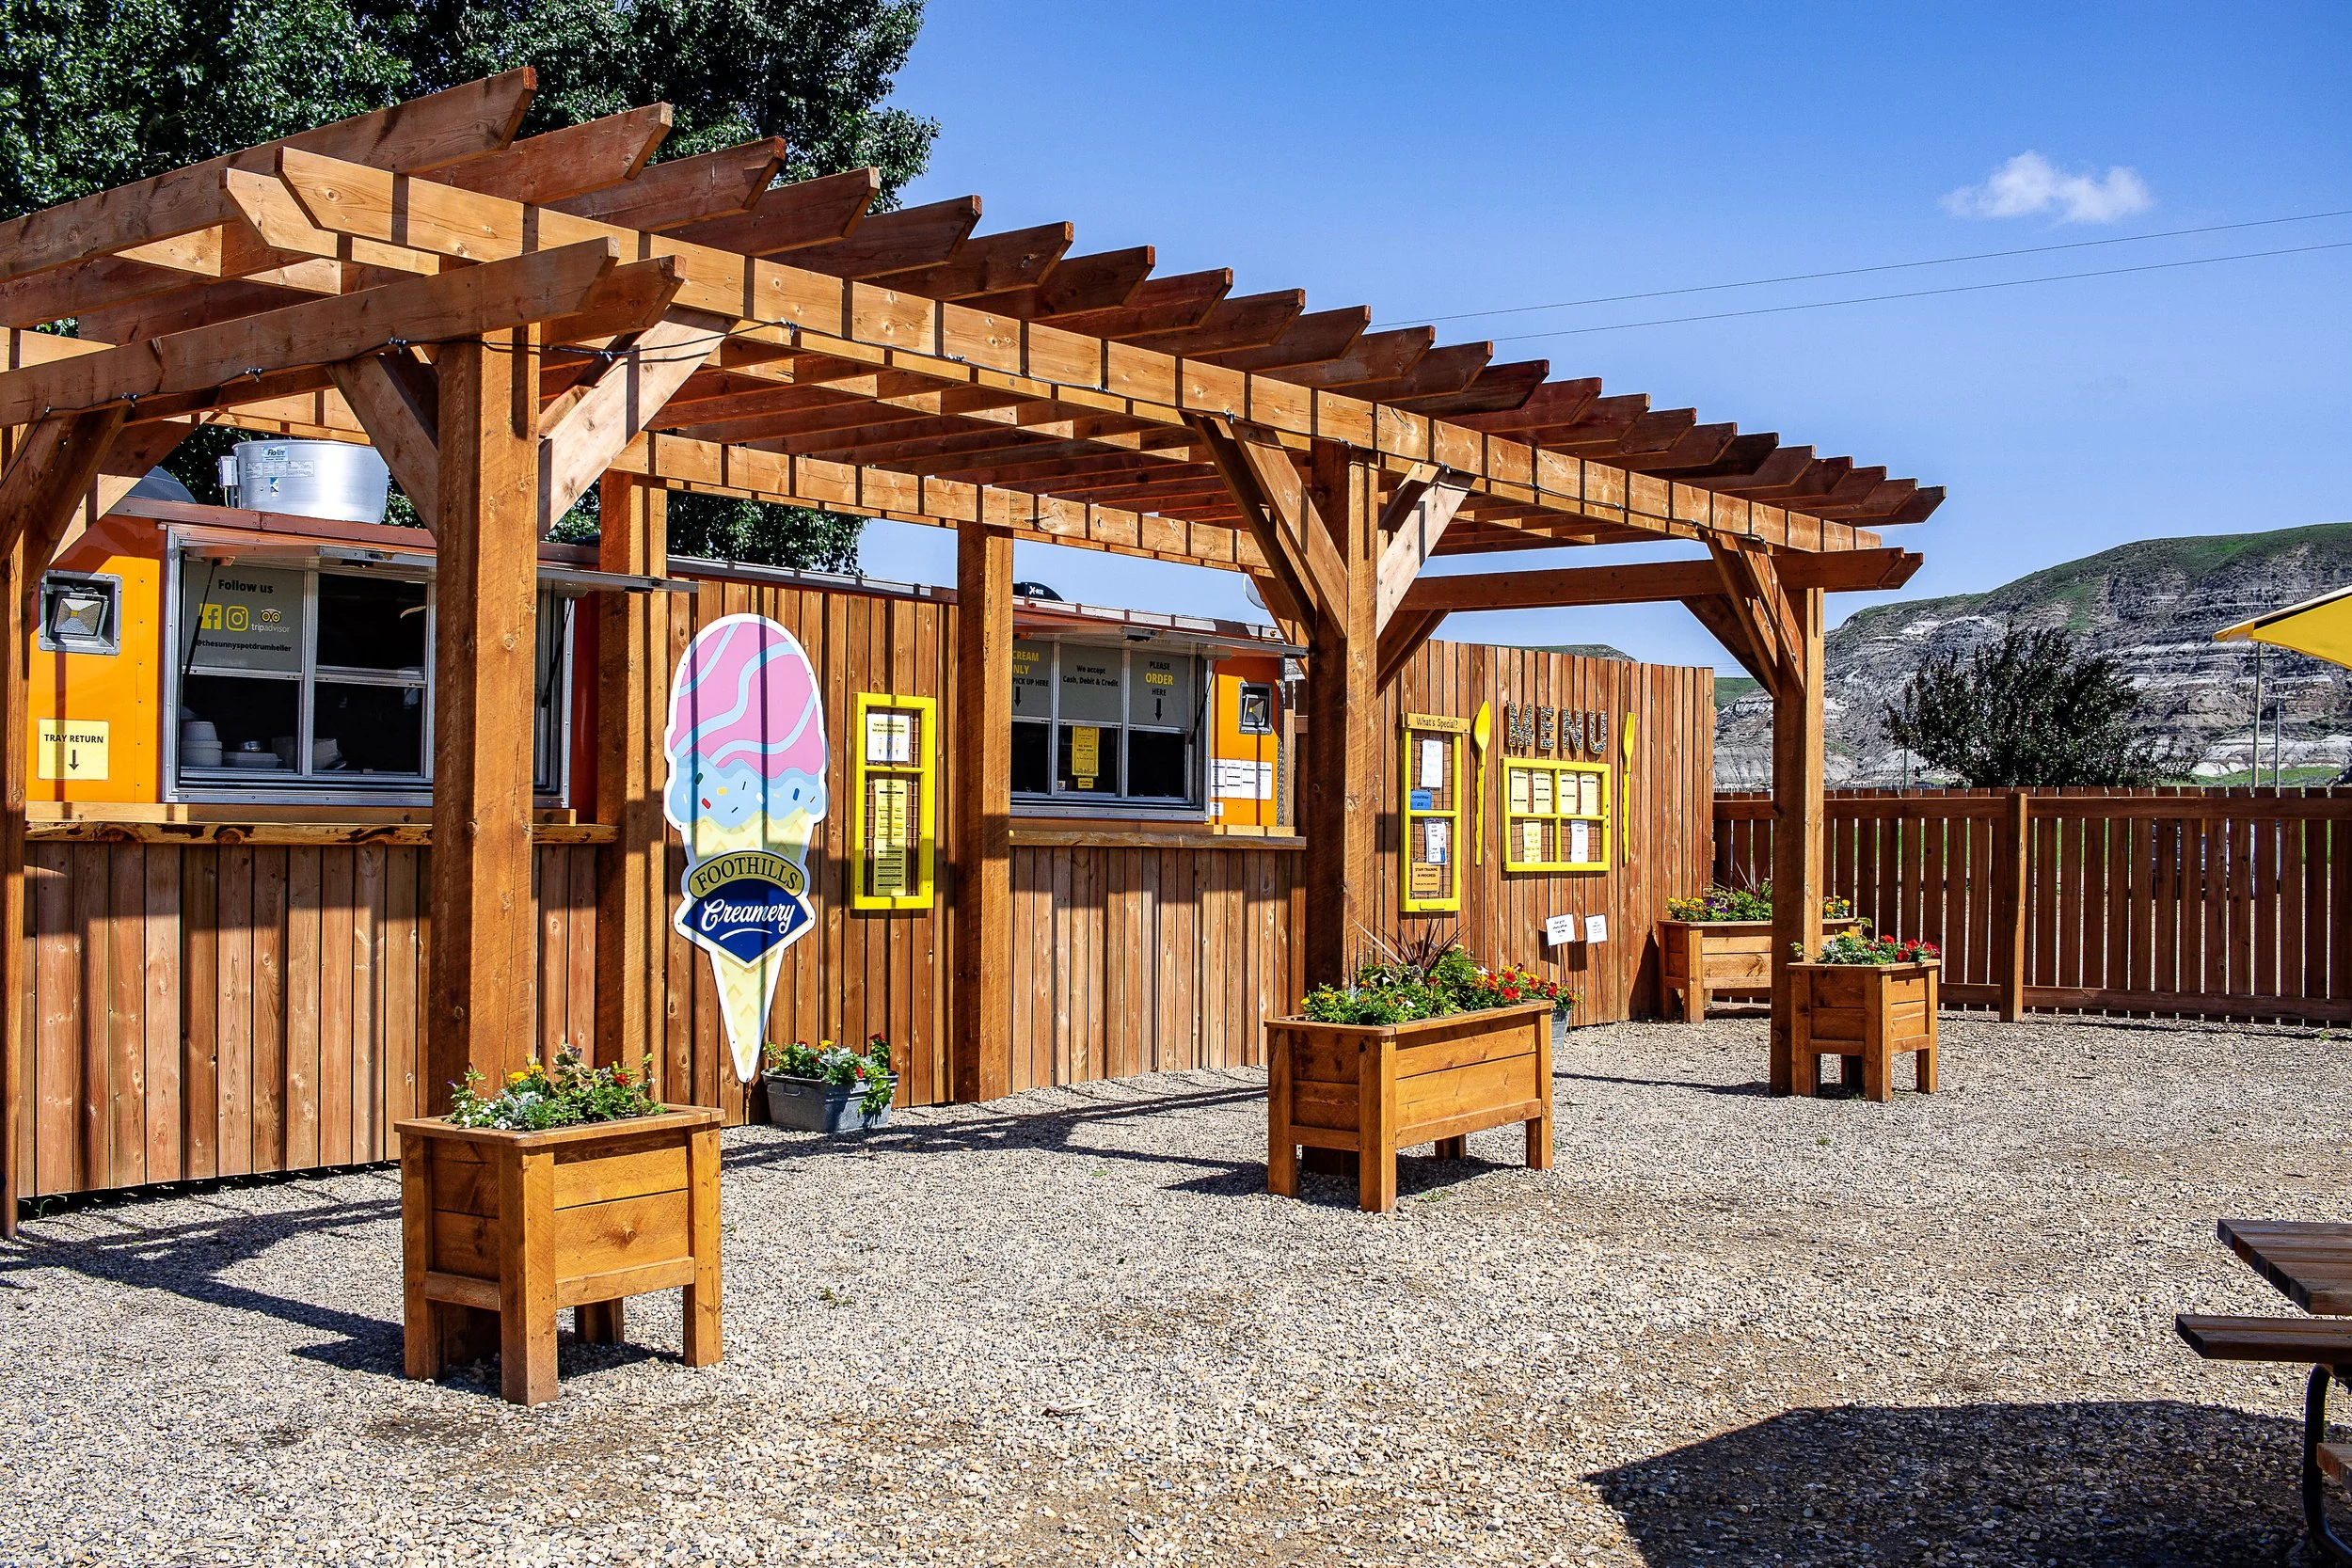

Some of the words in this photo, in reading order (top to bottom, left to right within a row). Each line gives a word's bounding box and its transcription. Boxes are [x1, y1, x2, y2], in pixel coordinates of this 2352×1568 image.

[218, 579, 257, 593] Follow
[260, 583, 274, 594] us
[251, 623, 291, 633] tripadvisor
[1012, 650, 1040, 662] CREAM
[1012, 664, 1030, 674] NLY
[1076, 664, 1087, 673] We
[1087, 667, 1106, 675] accept
[1149, 660, 1170, 671] PLEASE
[1012, 677, 1025, 686] PICK
[1035, 679, 1049, 688] HERE
[1079, 676, 1095, 686] Debit
[1101, 678, 1119, 688] Credit
[1145, 673, 1173, 686] ORDER
[1152, 688, 1167, 697] HERE
[1416, 716, 1436, 727] What's
[1437, 718, 1458, 730] Special?
[1509, 701, 1608, 753] MENU
[44, 734, 67, 742] TRAY
[70, 735, 103, 743] RETURN
[694, 856, 799, 893] FOOTHILLS
[700, 898, 796, 934] Creamery
